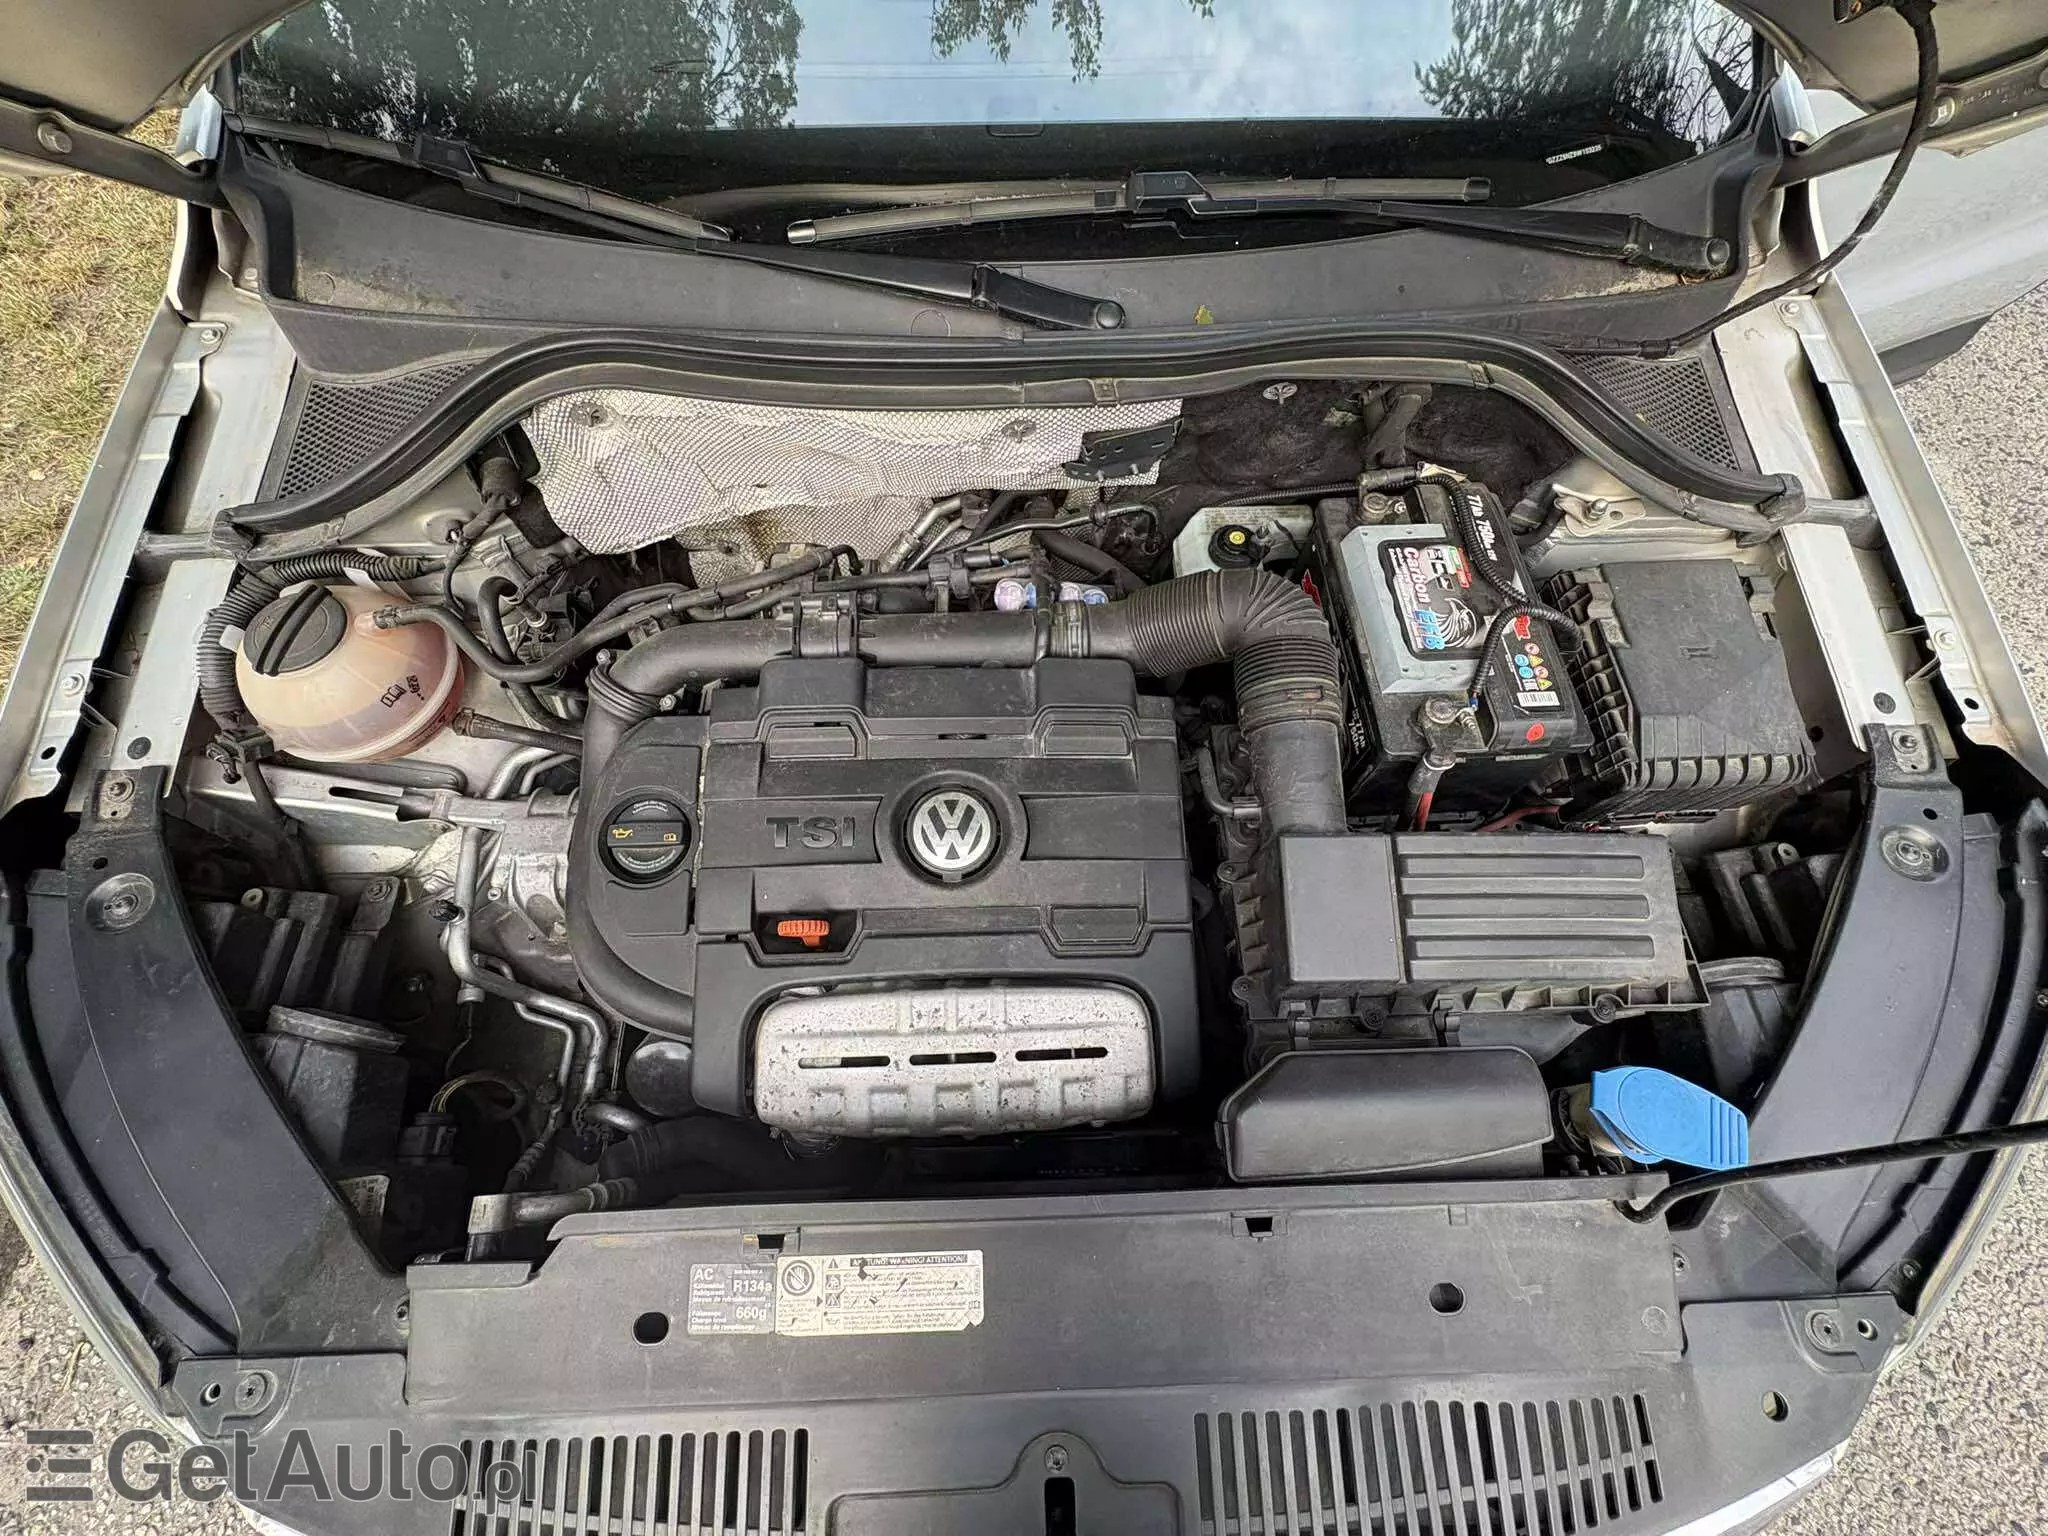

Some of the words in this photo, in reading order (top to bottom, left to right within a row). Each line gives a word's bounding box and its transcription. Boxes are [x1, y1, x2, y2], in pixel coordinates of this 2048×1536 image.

[1403, 547, 1431, 603] Carbon
[1413, 610, 1445, 650] EFB
[766, 816, 855, 849] TSI
[694, 1267, 714, 1281] AC
[733, 1280, 773, 1292] R134a
[735, 1306, 767, 1321] 660g
